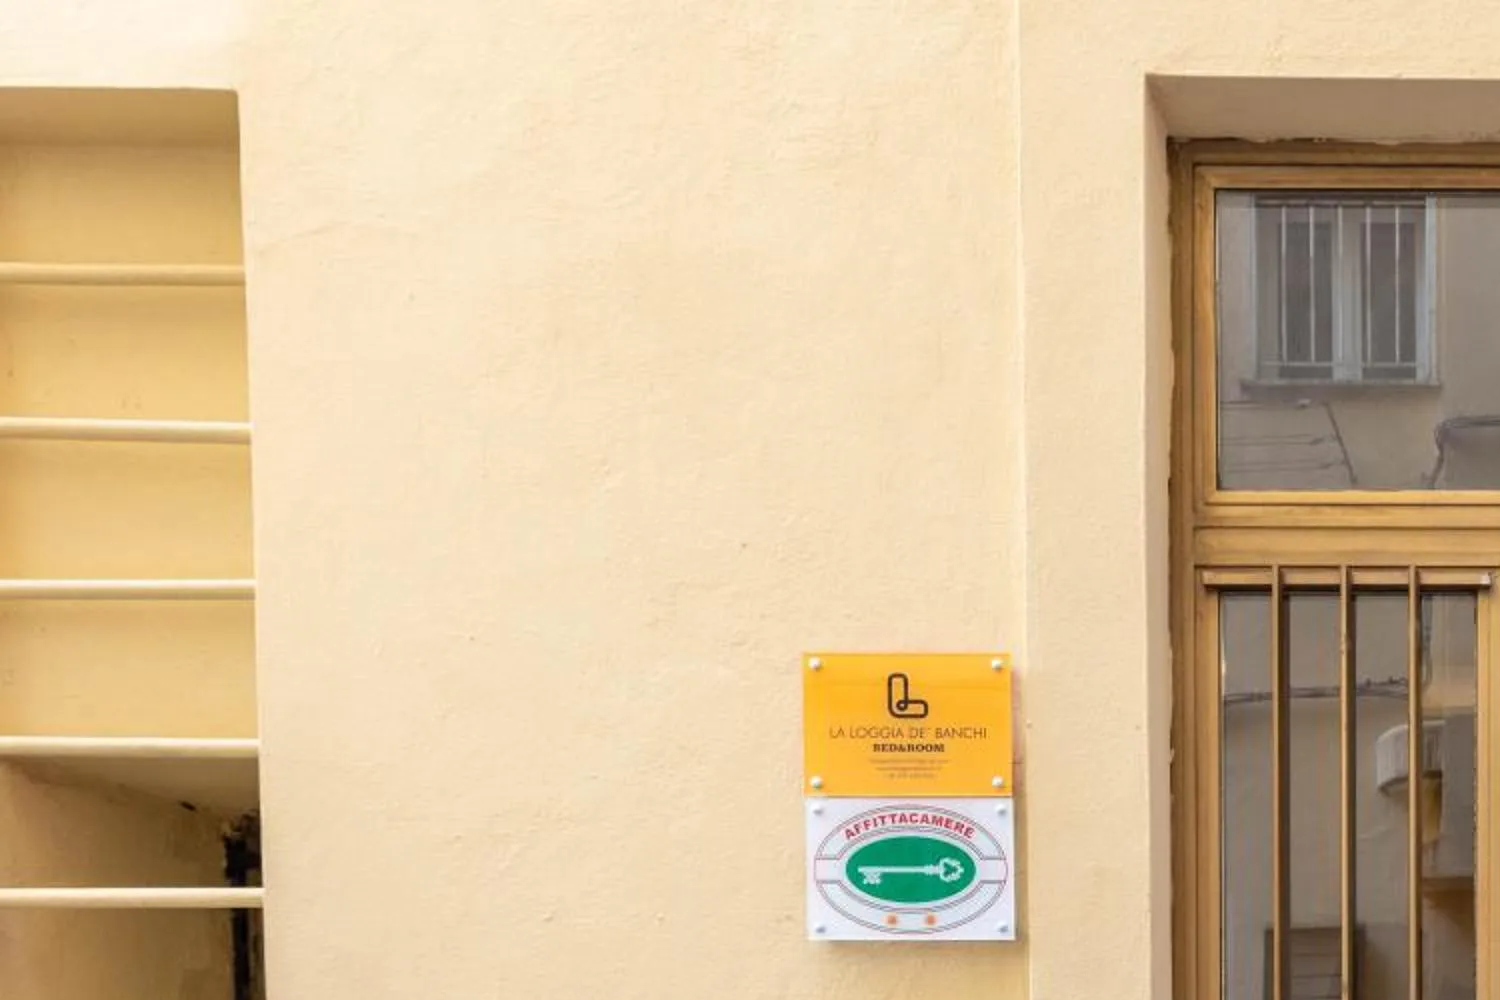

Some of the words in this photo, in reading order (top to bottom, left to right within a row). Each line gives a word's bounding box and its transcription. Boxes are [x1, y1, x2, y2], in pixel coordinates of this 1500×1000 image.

[828, 726, 846, 739] LA
[849, 726, 905, 739] LOGGIA
[935, 726, 988, 739] BANCHI
[843, 812, 976, 840] AFFITTACAMERE
